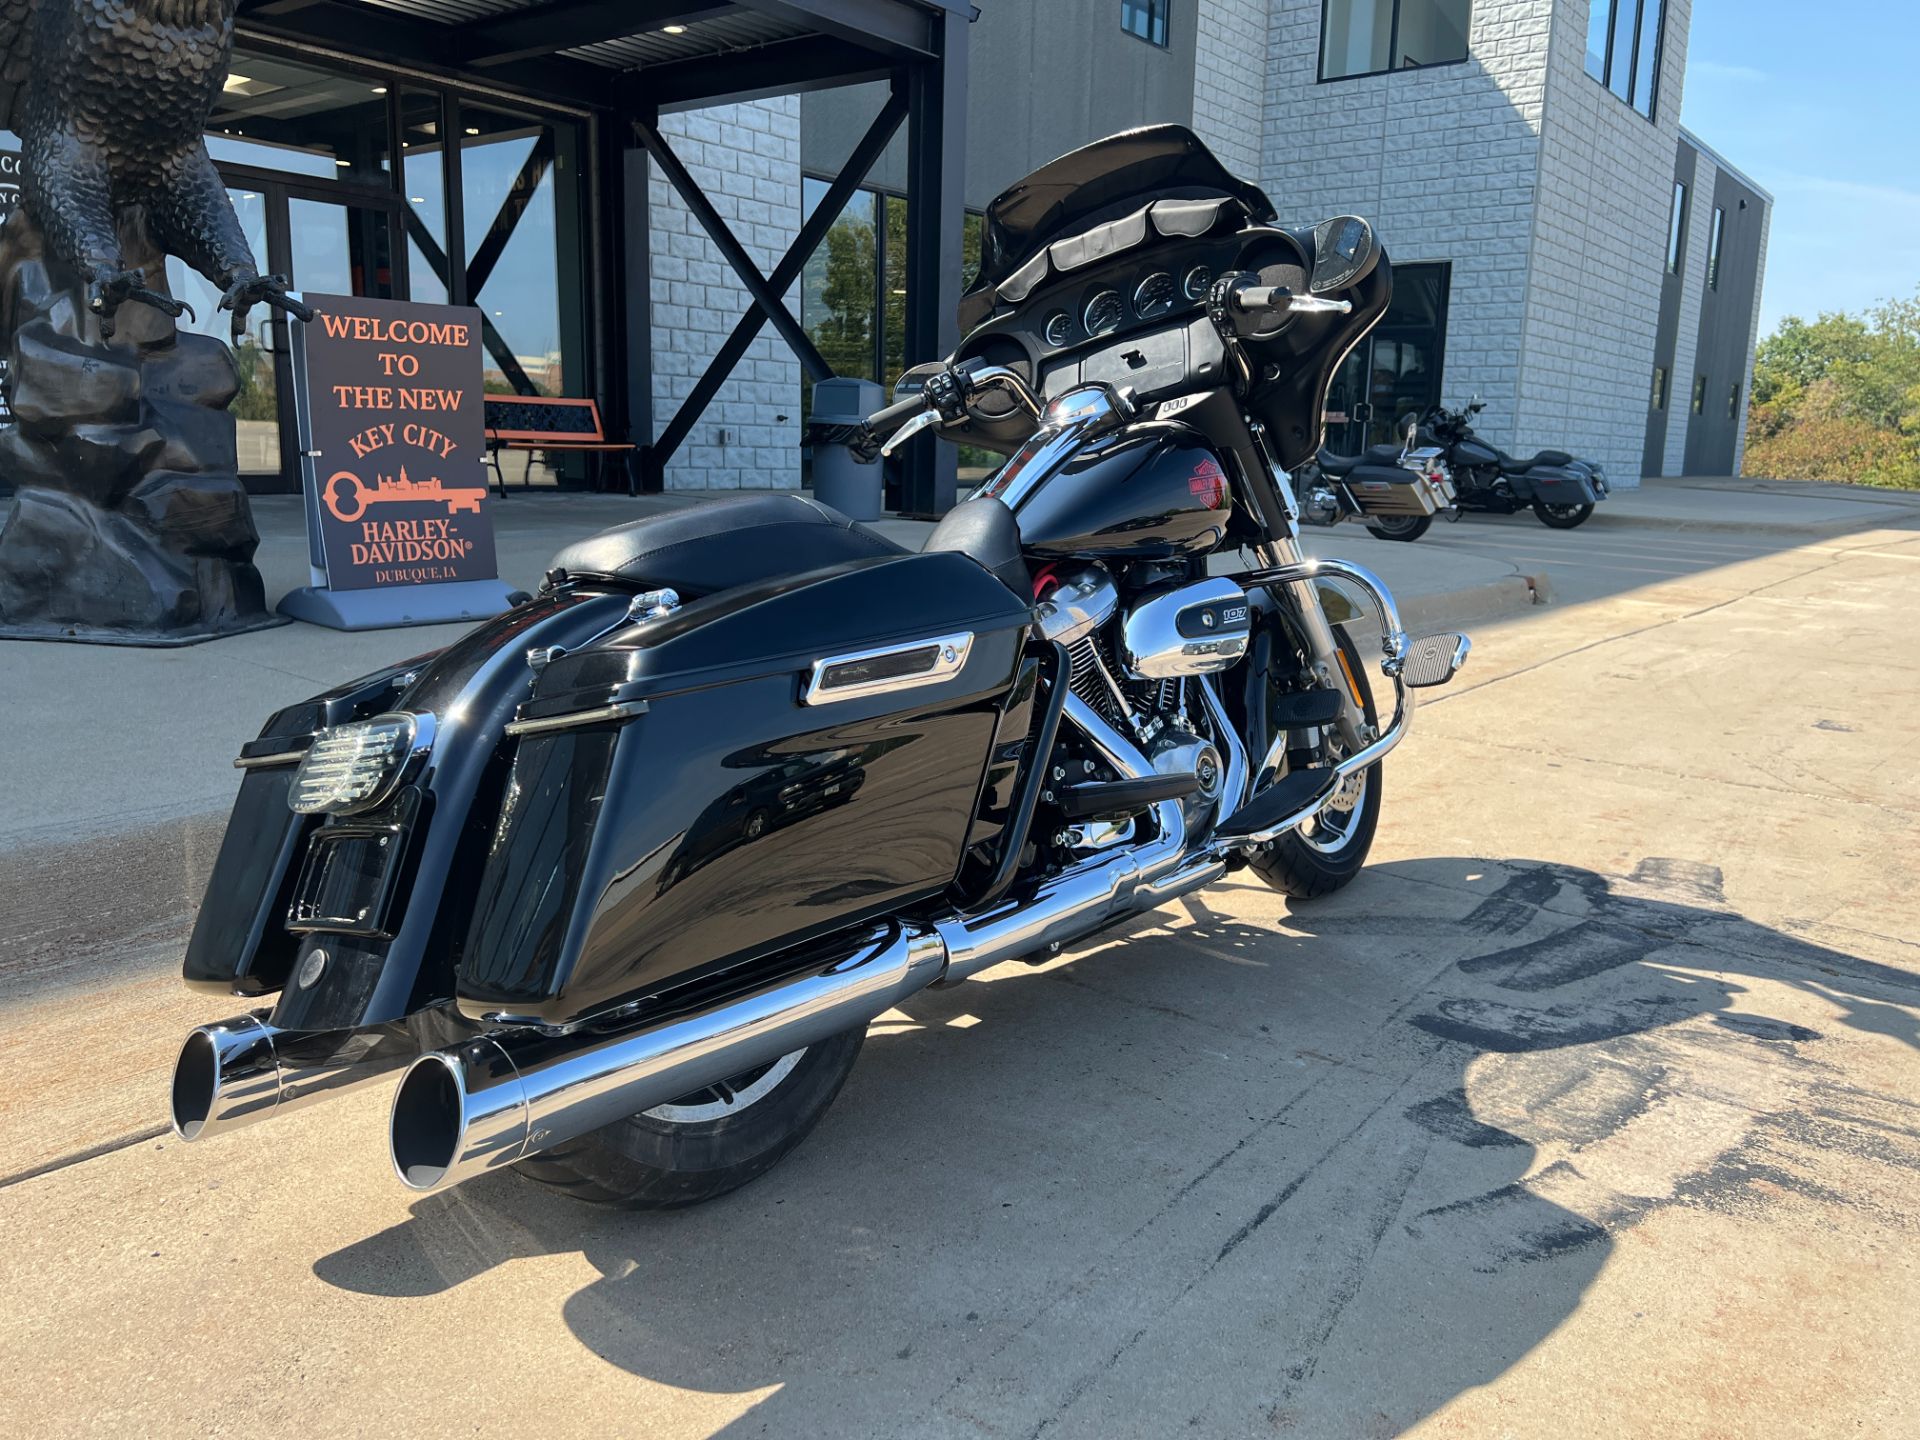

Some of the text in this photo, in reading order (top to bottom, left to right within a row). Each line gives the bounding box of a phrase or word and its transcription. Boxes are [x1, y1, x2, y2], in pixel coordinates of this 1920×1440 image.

[321, 313, 469, 347] WELCOME
[378, 352, 420, 377] TO
[333, 385, 463, 412] THE NEW
[347, 423, 458, 460] KEY CITY
[361, 518, 458, 543] HARLEY-
[375, 565, 457, 583] DUBUQUE, IA
[1223, 606, 1247, 621] 107
